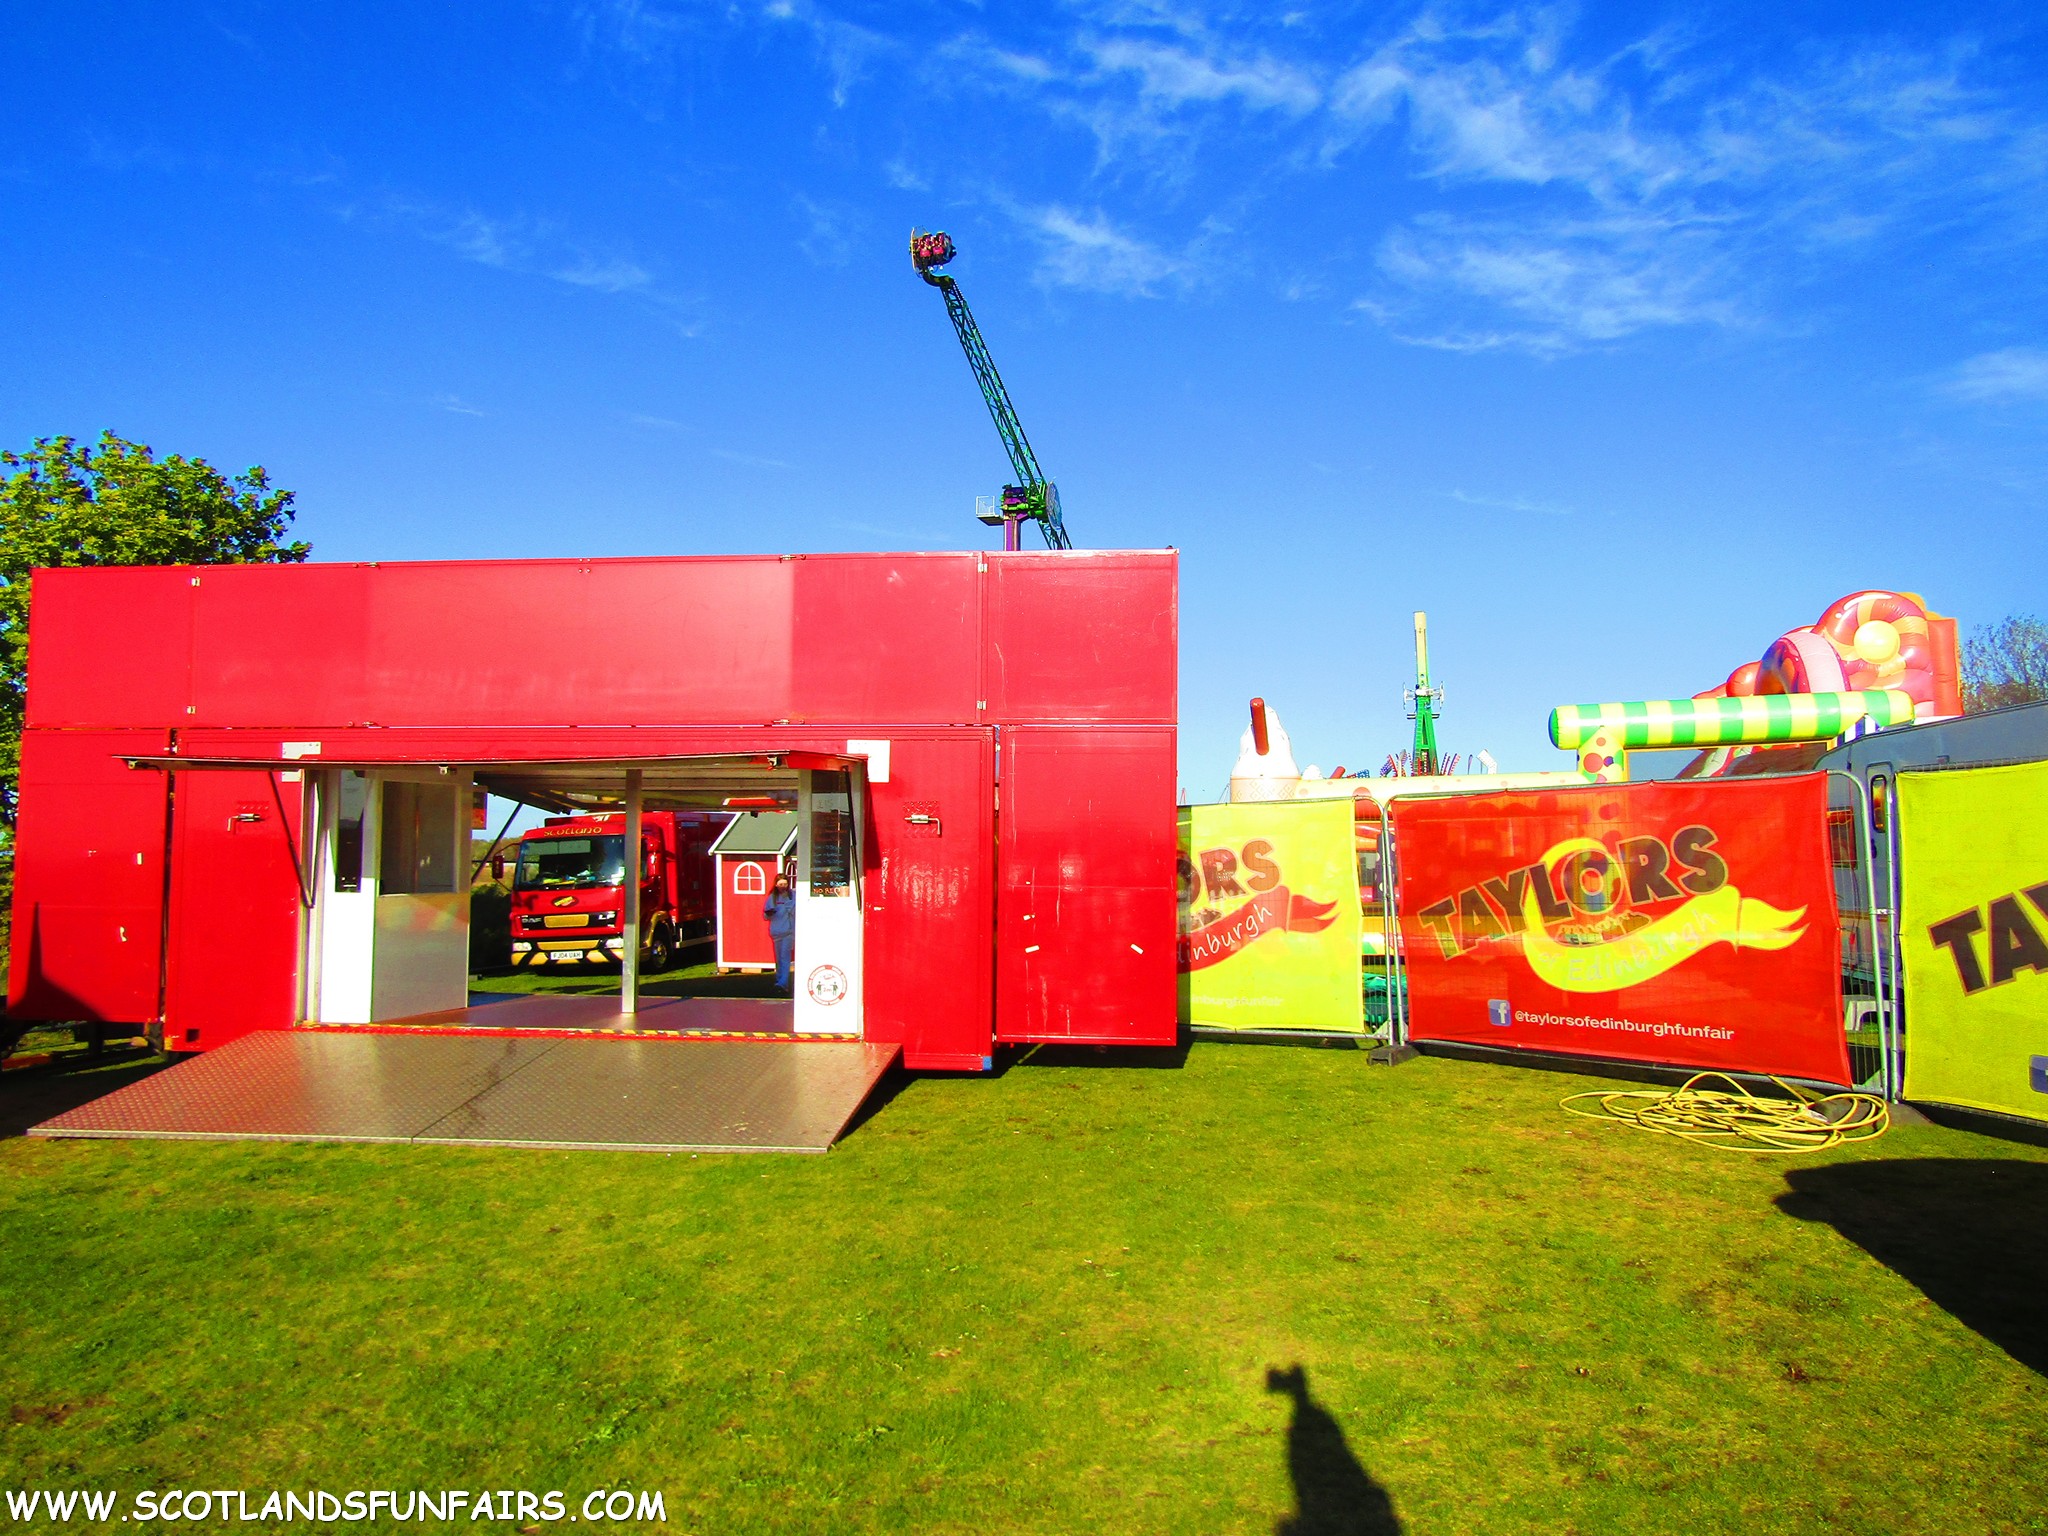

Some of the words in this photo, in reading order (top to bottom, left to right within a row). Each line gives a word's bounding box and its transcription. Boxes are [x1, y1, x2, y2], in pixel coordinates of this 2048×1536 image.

[1417, 824, 1728, 960] TAYLORS
[1567, 908, 1718, 982] Edinburgh
[1514, 1010, 1735, 1040] @taylorsofedinburghfunfair
